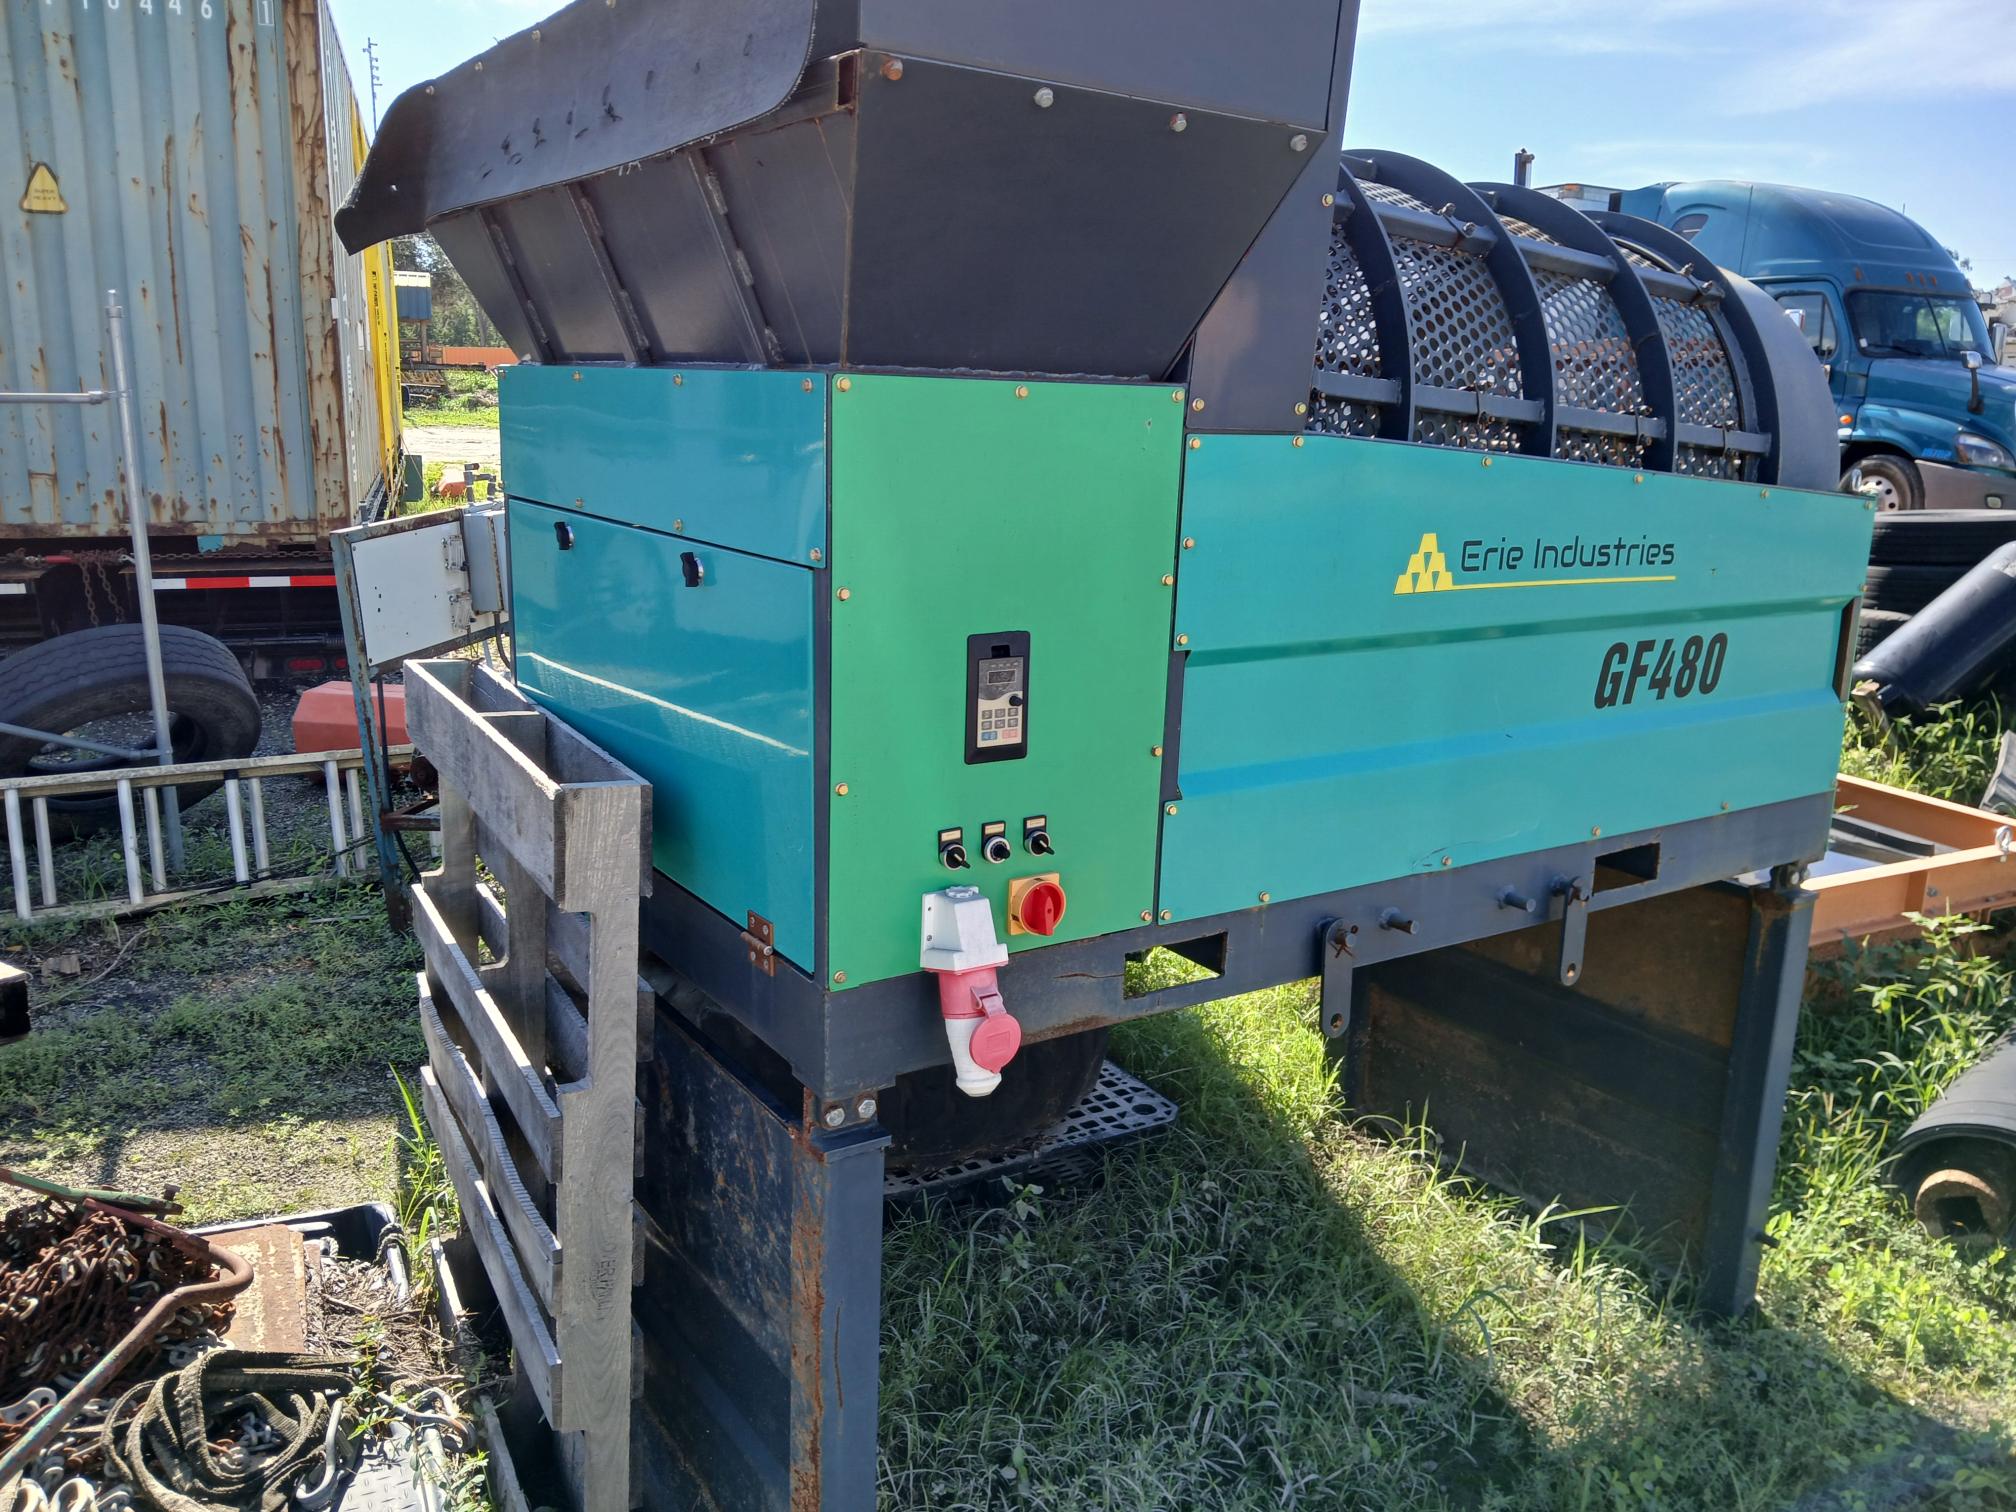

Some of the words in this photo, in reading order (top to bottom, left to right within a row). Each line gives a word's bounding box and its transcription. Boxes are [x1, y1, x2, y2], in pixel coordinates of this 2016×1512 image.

[1461, 537, 1523, 571] Erie
[1533, 535, 1675, 568] Industries
[1593, 632, 1728, 709] GF480
